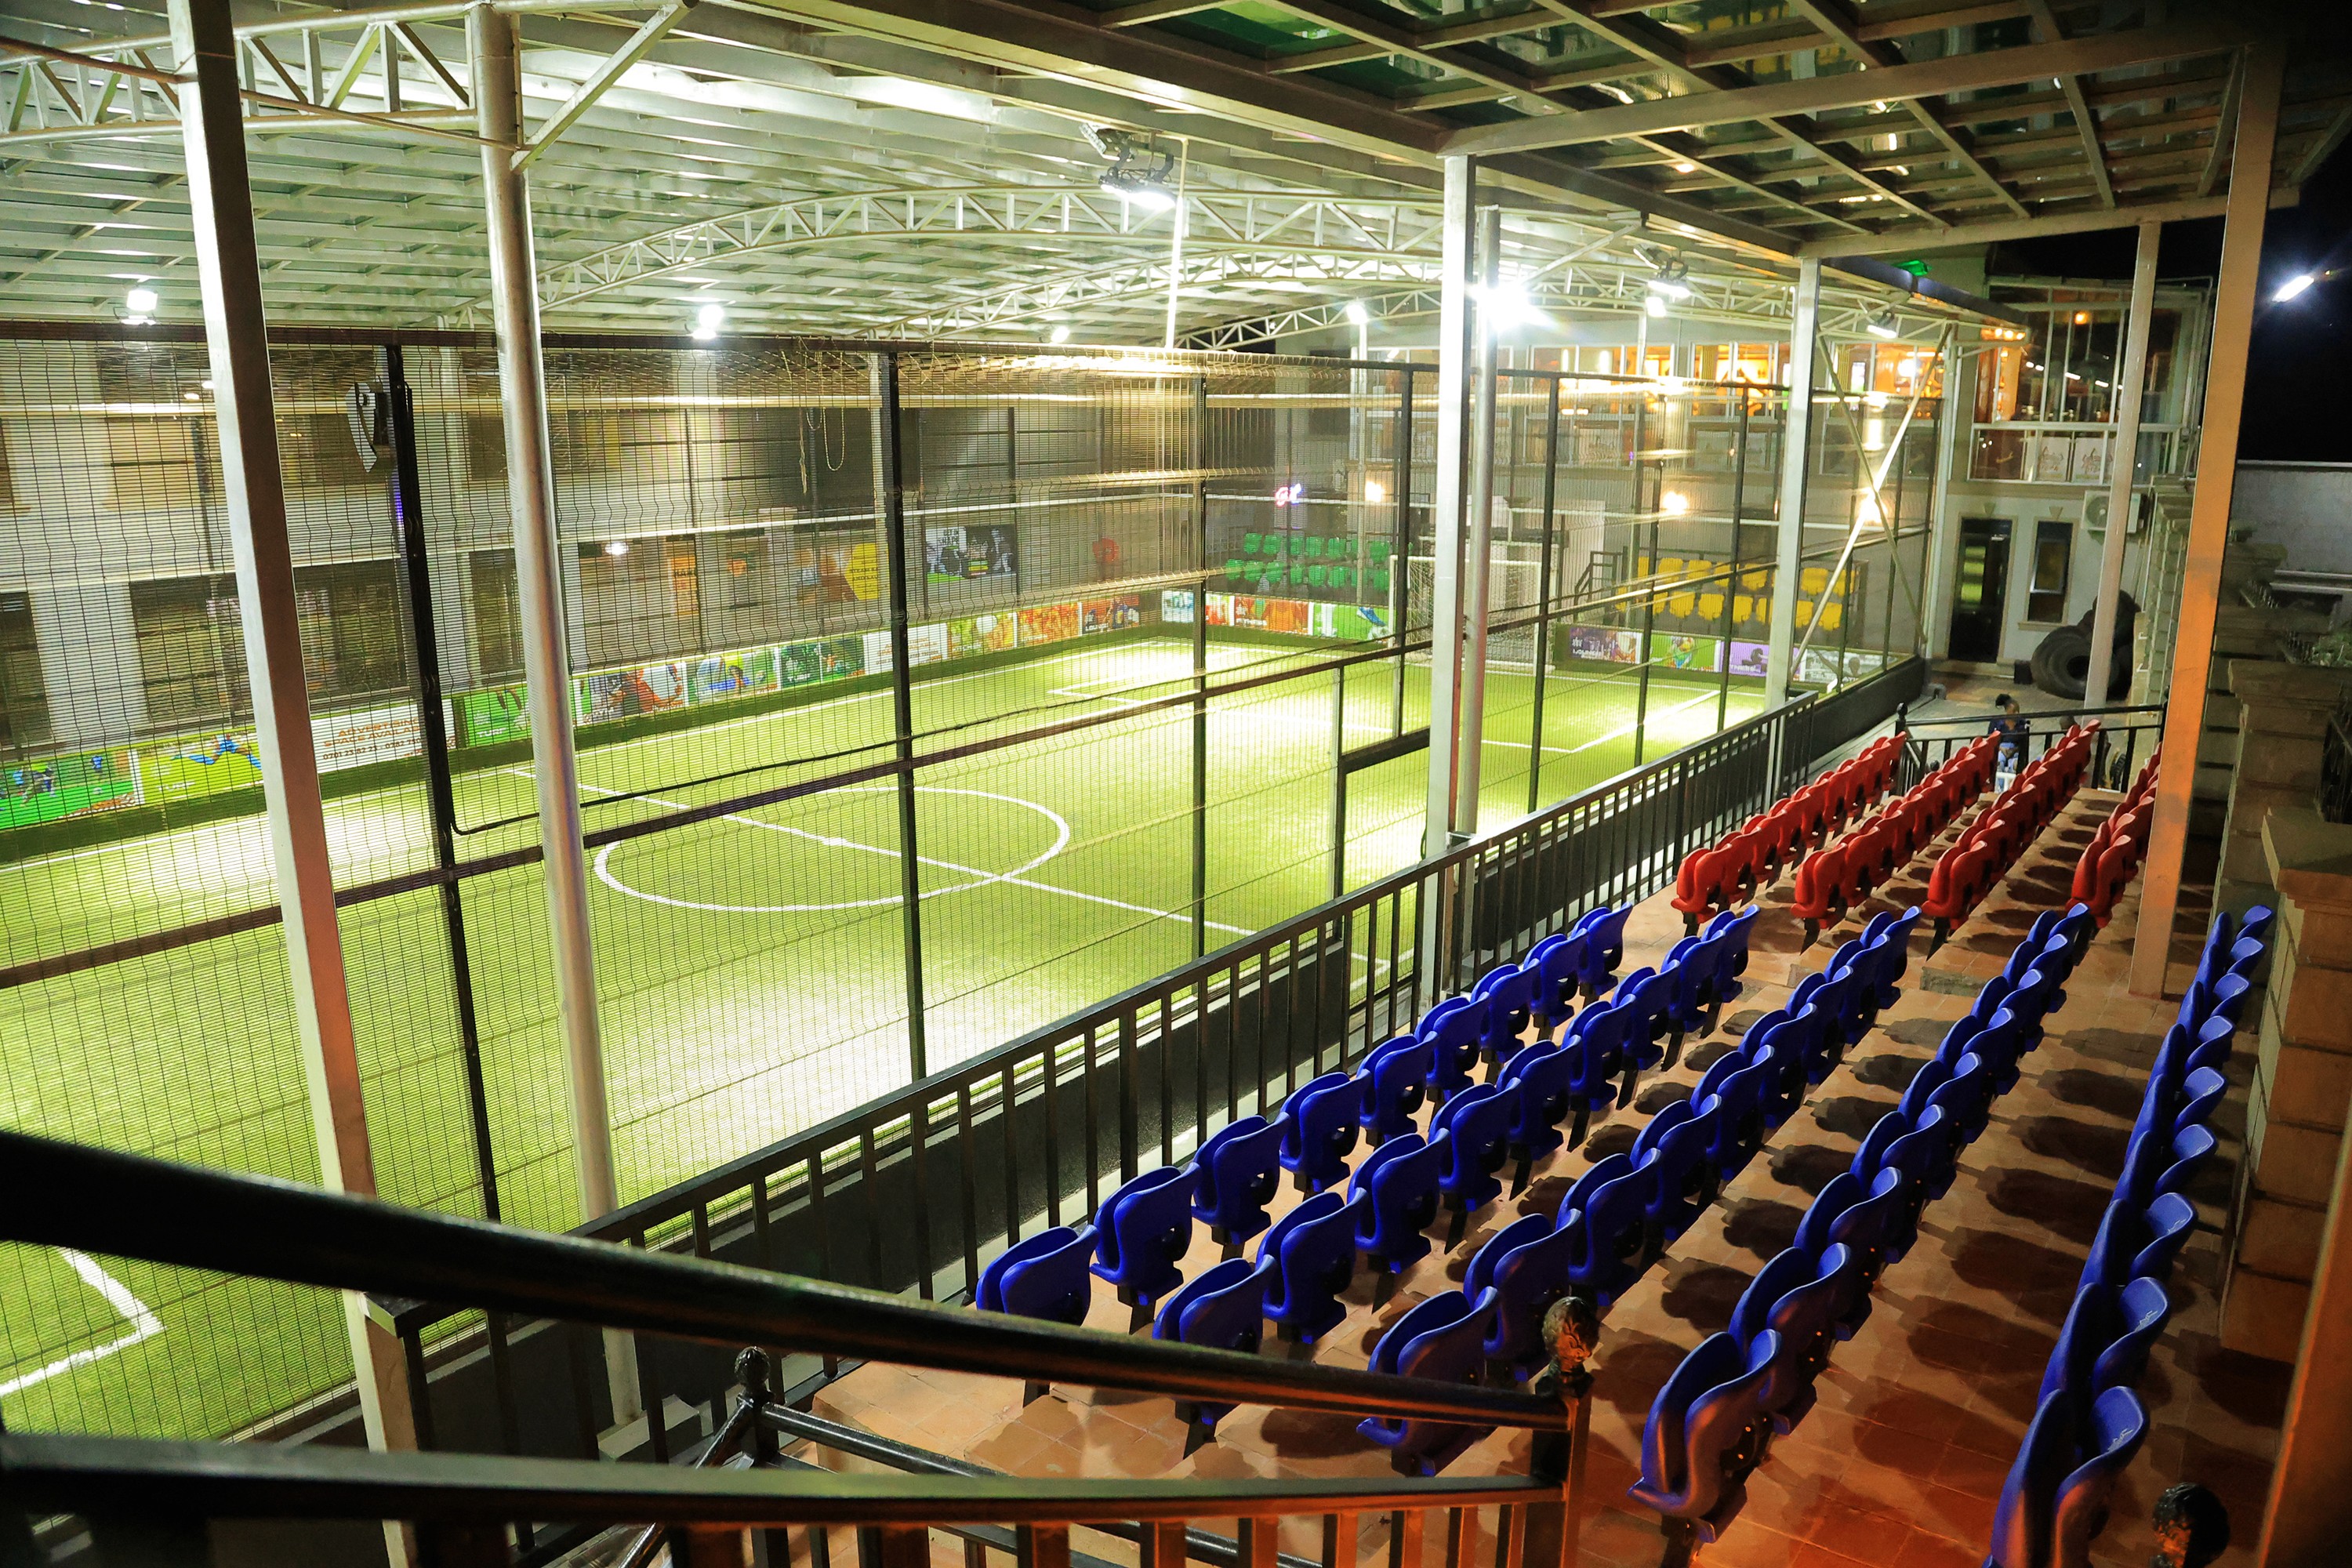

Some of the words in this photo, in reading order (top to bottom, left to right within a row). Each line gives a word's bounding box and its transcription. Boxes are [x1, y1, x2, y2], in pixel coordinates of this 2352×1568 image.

[324, 735, 365, 747] SPACE
[368, 726, 421, 739] AVAILAB
[477, 728, 506, 738] TURF
